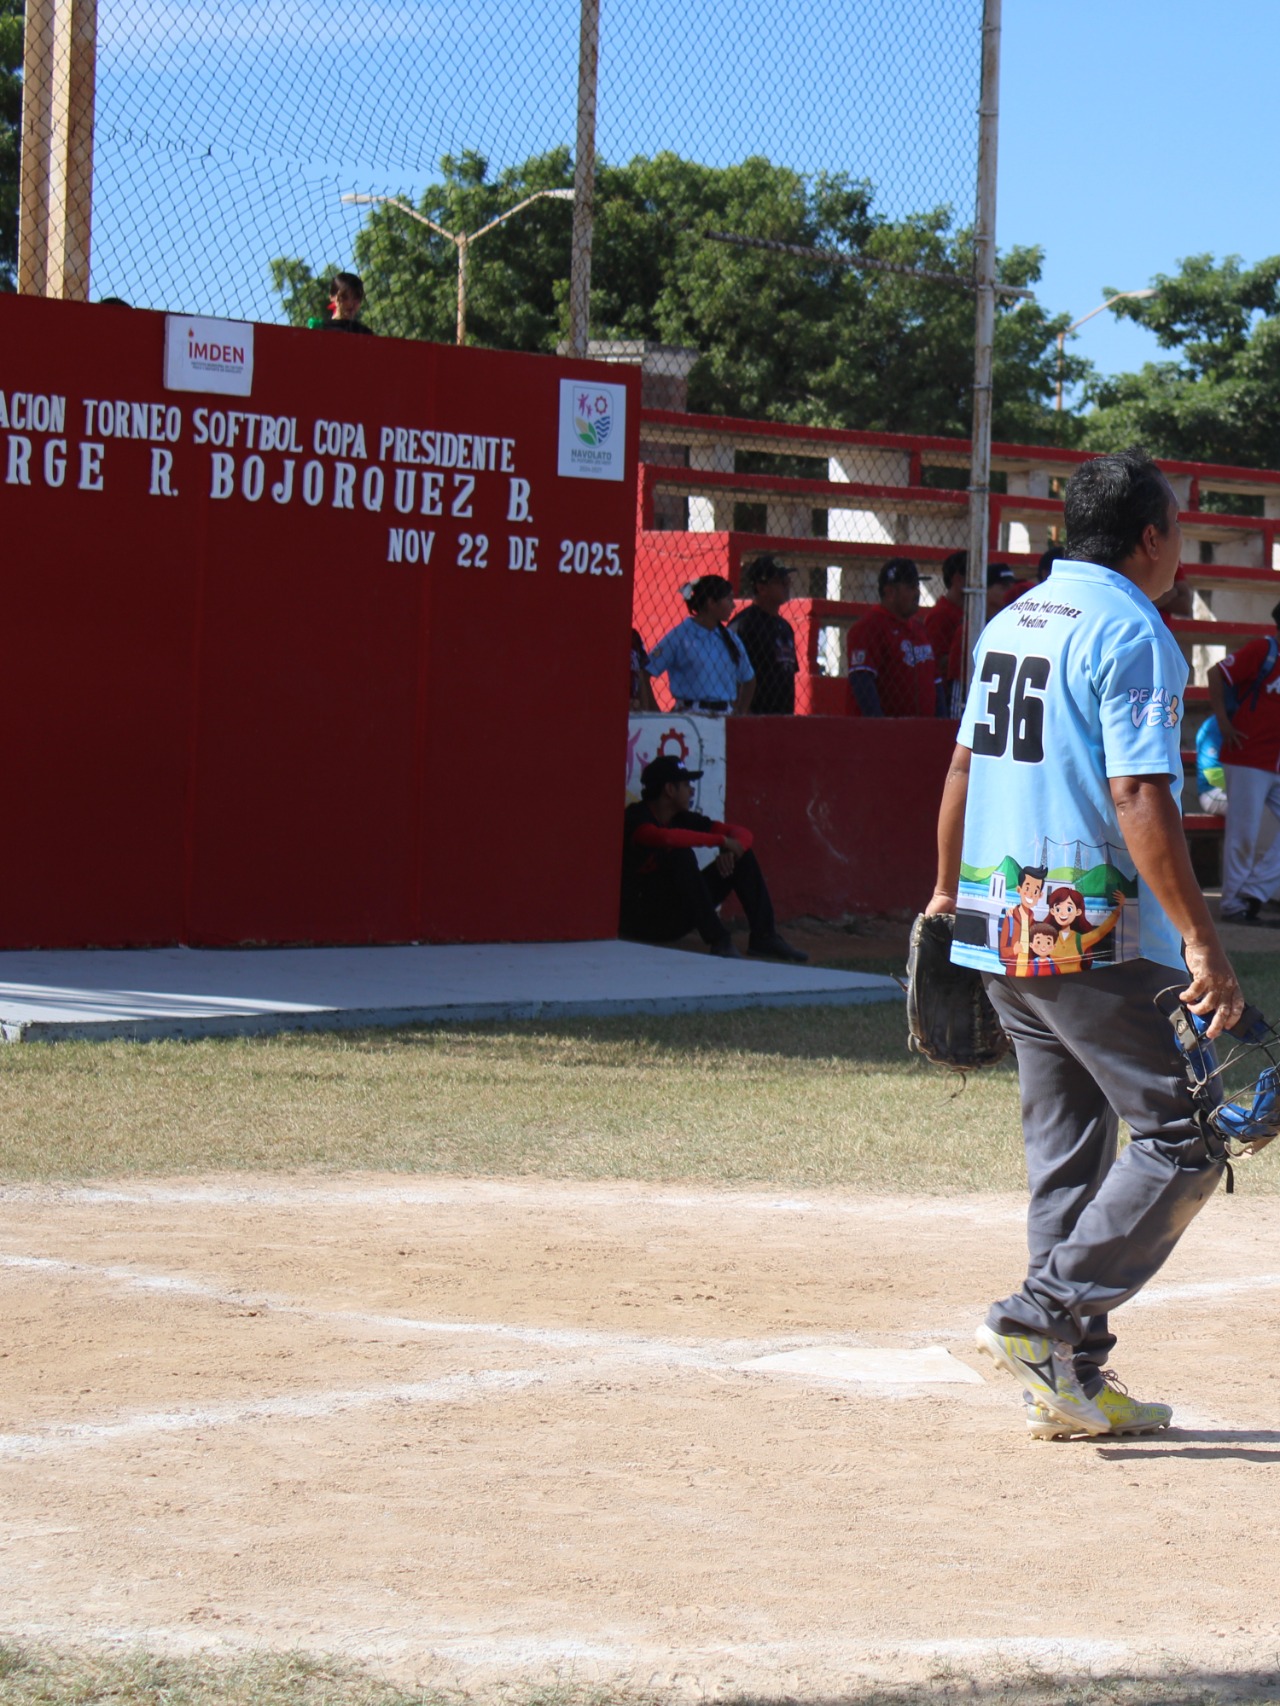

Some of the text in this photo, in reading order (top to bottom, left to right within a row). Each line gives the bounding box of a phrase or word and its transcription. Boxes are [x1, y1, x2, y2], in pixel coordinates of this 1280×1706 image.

[188, 341, 245, 365] IMDEN
[83, 399, 182, 442] TORNEO
[193, 408, 303, 453] SOFTBOL
[313, 419, 367, 459] COPA
[379, 427, 516, 473] PRESIDENTE
[571, 449, 613, 461] NAVOLATO
[5, 434, 534, 523] RGE R. BOJORQUEZ B.
[387, 528, 623, 576] NOV 22 DE 2025.
[971, 651, 1051, 764] 36
[1126, 688, 1149, 704] DE
